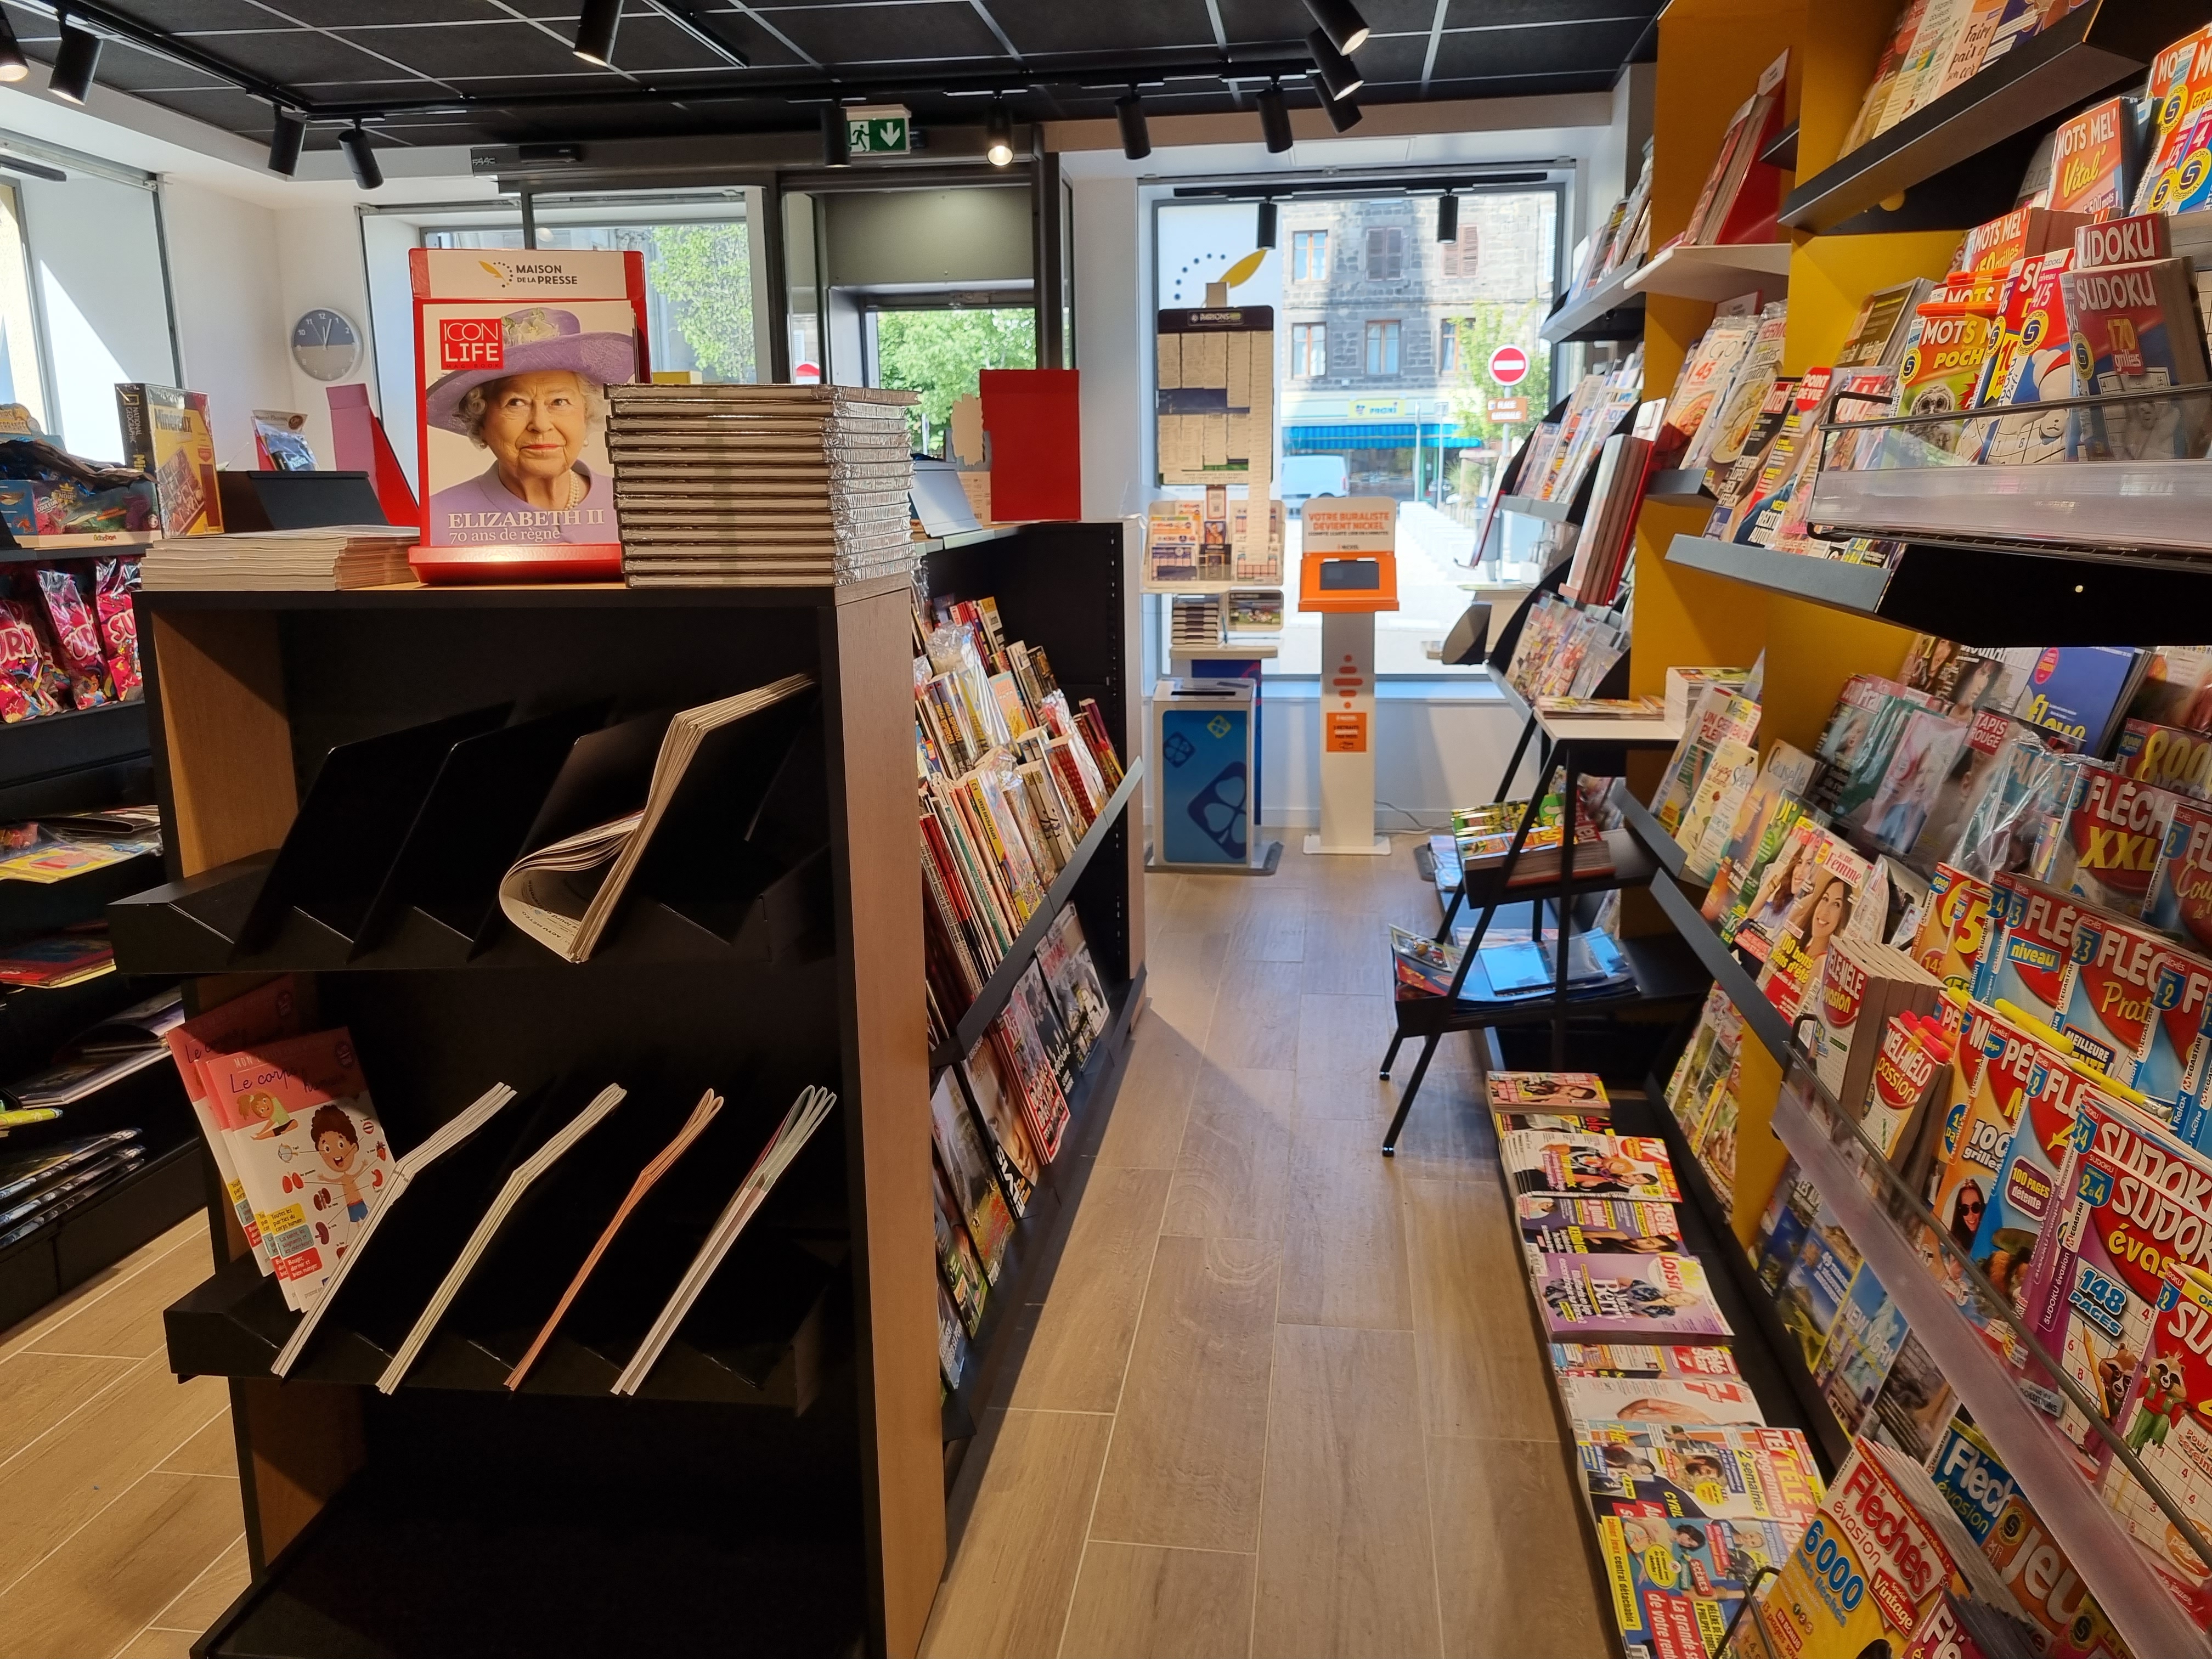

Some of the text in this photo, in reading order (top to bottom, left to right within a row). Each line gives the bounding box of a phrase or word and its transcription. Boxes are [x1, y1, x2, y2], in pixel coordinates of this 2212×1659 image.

[2057, 121, 2087, 160] MOTS
[2187, 150, 2209, 163] SPORT
[1973, 221, 2002, 254] MOTS
[2076, 218, 2156, 269] SUDOKU
[516, 265, 561, 273] MAISON
[1996, 244, 2019, 269] grilles
[2043, 257, 2063, 268] SUDOKU
[538, 275, 577, 285] PRESSE
[2076, 271, 2157, 312] SUDOKU
[2031, 283, 2051, 308] 4/5
[2027, 311, 2047, 323] SPORT
[444, 323, 498, 341] ICON
[1921, 319, 1977, 346] MOTS
[445, 343, 499, 362] LIFE
[1933, 348, 1985, 369] POCH
[2114, 347, 2142, 368] grilles
[1797, 388, 1825, 401] DE VUE
[1804, 373, 1830, 390] POINT
[126, 407, 137, 443] GEOGRAPHIC
[133, 407, 143, 436] NATIONAL
[449, 510, 605, 529] ELIZABETH II
[1308, 511, 1390, 521] VOTRE BURALISTE
[1313, 522, 1351, 531] DEVIENT
[449, 527, 560, 544] 70 ans de règne
[941, 718, 955, 745] SPIROU
[948, 714, 962, 742] SPIROU
[1977, 713, 2007, 735] TAPIS
[2084, 774, 2176, 839] FLÉCH
[2078, 825, 2160, 871] XXL
[1825, 852, 1863, 883] Femme
[1793, 947, 1814, 971] bons
[2011, 942, 2056, 968] niveau
[1787, 960, 1810, 984] d'été
[2102, 981, 2153, 1024] Prat
[1883, 1028, 1934, 1088] MÉLI-MÉLO
[2066, 1030, 2110, 1062] MEILLEURE
[2181, 1036, 2203, 1091] MEGASTAR
[230, 1072, 253, 1094] Le
[1877, 1057, 1916, 1103] passion
[2172, 1096, 2187, 1125] Relax
[2089, 1154, 2115, 1173] SUDOKU
[2011, 1166, 2050, 1199] 100 PAGES
[2011, 1186, 2041, 1210] détente
[2066, 1201, 2085, 1248] MEGASTAR
[2112, 1176, 2212, 1265] SUDOK
[1592, 1278, 1628, 1324] Berry
[2044, 1251, 2070, 1325] SUDOKU évasion
[2079, 1267, 2128, 1316] 148
[2068, 1290, 2124, 1336] PAGES
[1739, 1449, 1764, 1513] 2 semaines
[1755, 1448, 1787, 1517] Programmes
[1779, 1458, 1812, 1506] TÉLÉ
[1943, 1436, 2013, 1519] Fléch
[1833, 1499, 1882, 1568] évasion
[1842, 1460, 1932, 1596] Fléchés
[1615, 1556, 1626, 1582] central
[1691, 1560, 1708, 1593] SCÈNES
[1804, 1519, 1865, 1612] 6000
[1619, 1584, 1634, 1622] détachable
[1649, 1594, 1666, 1607] de
[1873, 1573, 1913, 1630] Vintage
[1891, 1581, 1908, 1602] Spécial
[1652, 1610, 1670, 1635] votre
[1670, 1599, 1699, 1646] La grande
